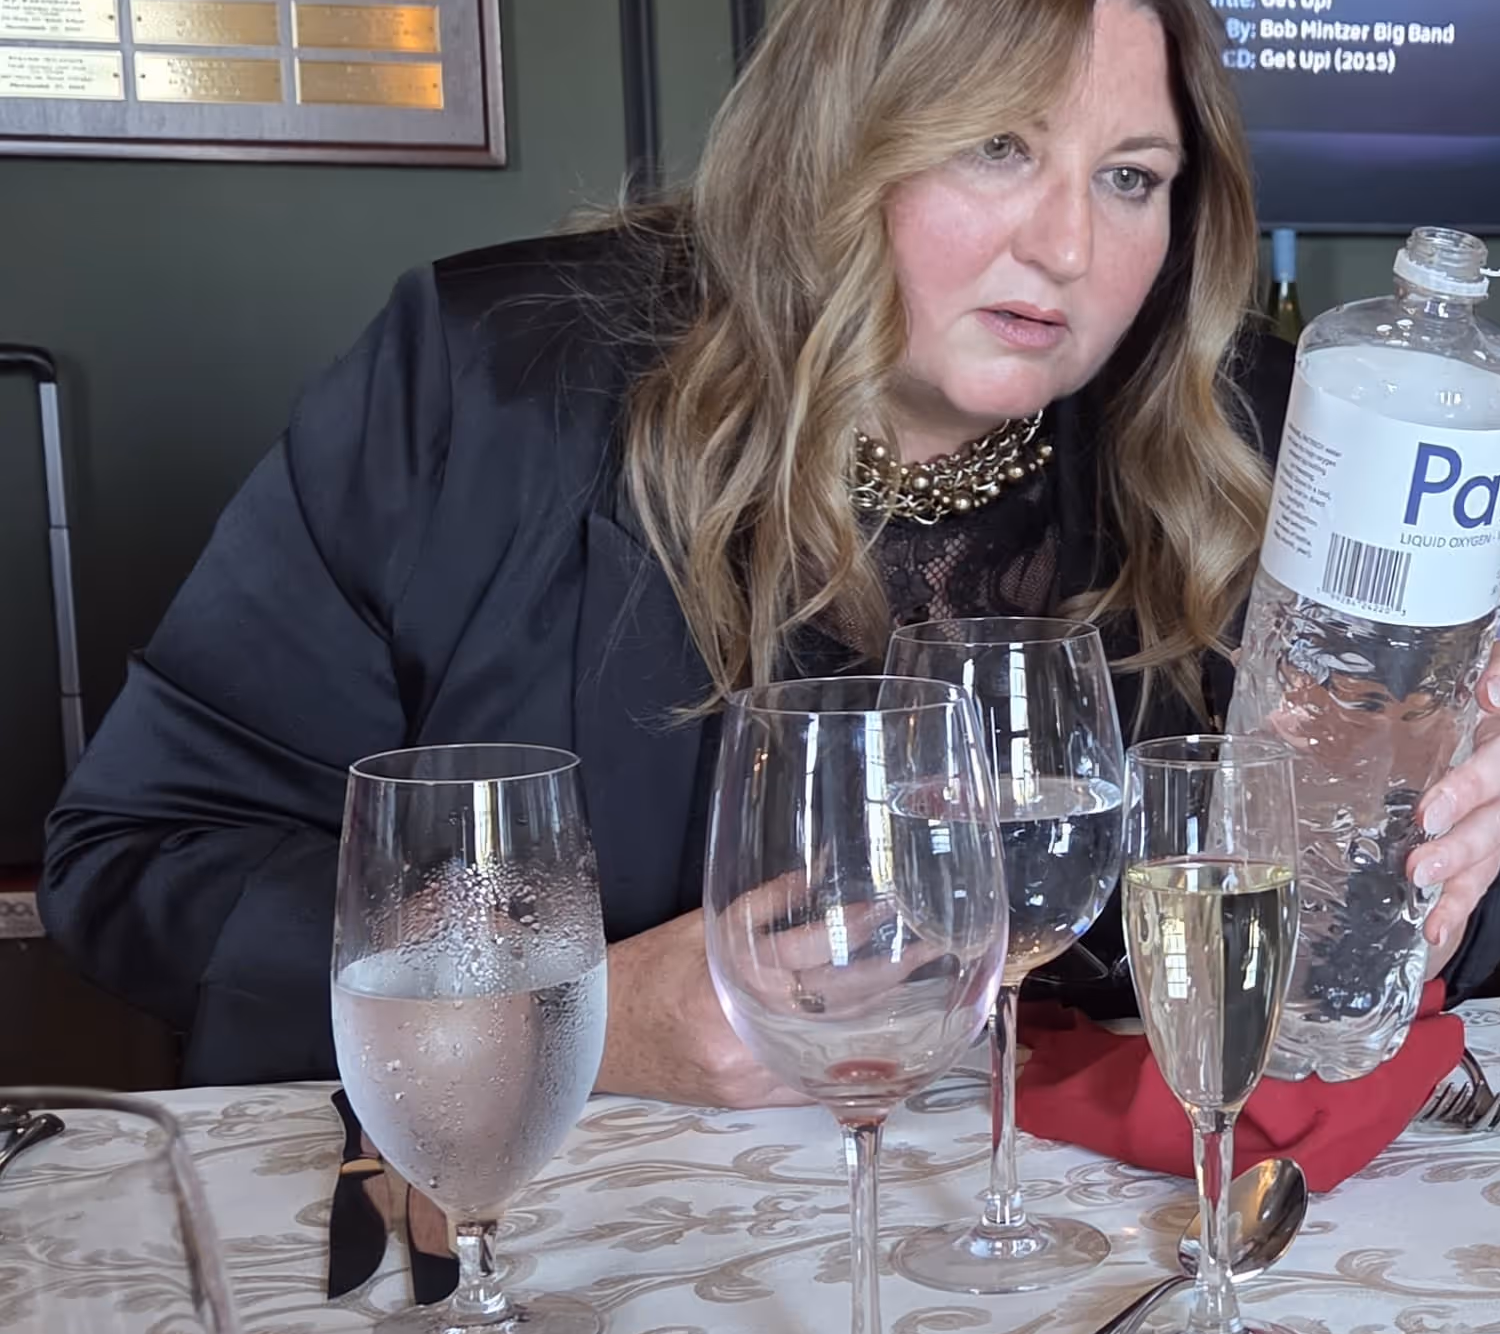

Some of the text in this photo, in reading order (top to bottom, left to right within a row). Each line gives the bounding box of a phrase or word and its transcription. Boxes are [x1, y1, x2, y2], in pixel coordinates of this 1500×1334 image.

[1225, 17, 1456, 46] By: Bob Mintzer Big Band
[1260, 48, 1297, 70] Get
[1300, 49, 1331, 73] Up!
[1334, 46, 1396, 74] (2015)
[1400, 532, 1446, 548] LIQUID
[1449, 533, 1491, 548] OXYGEN
